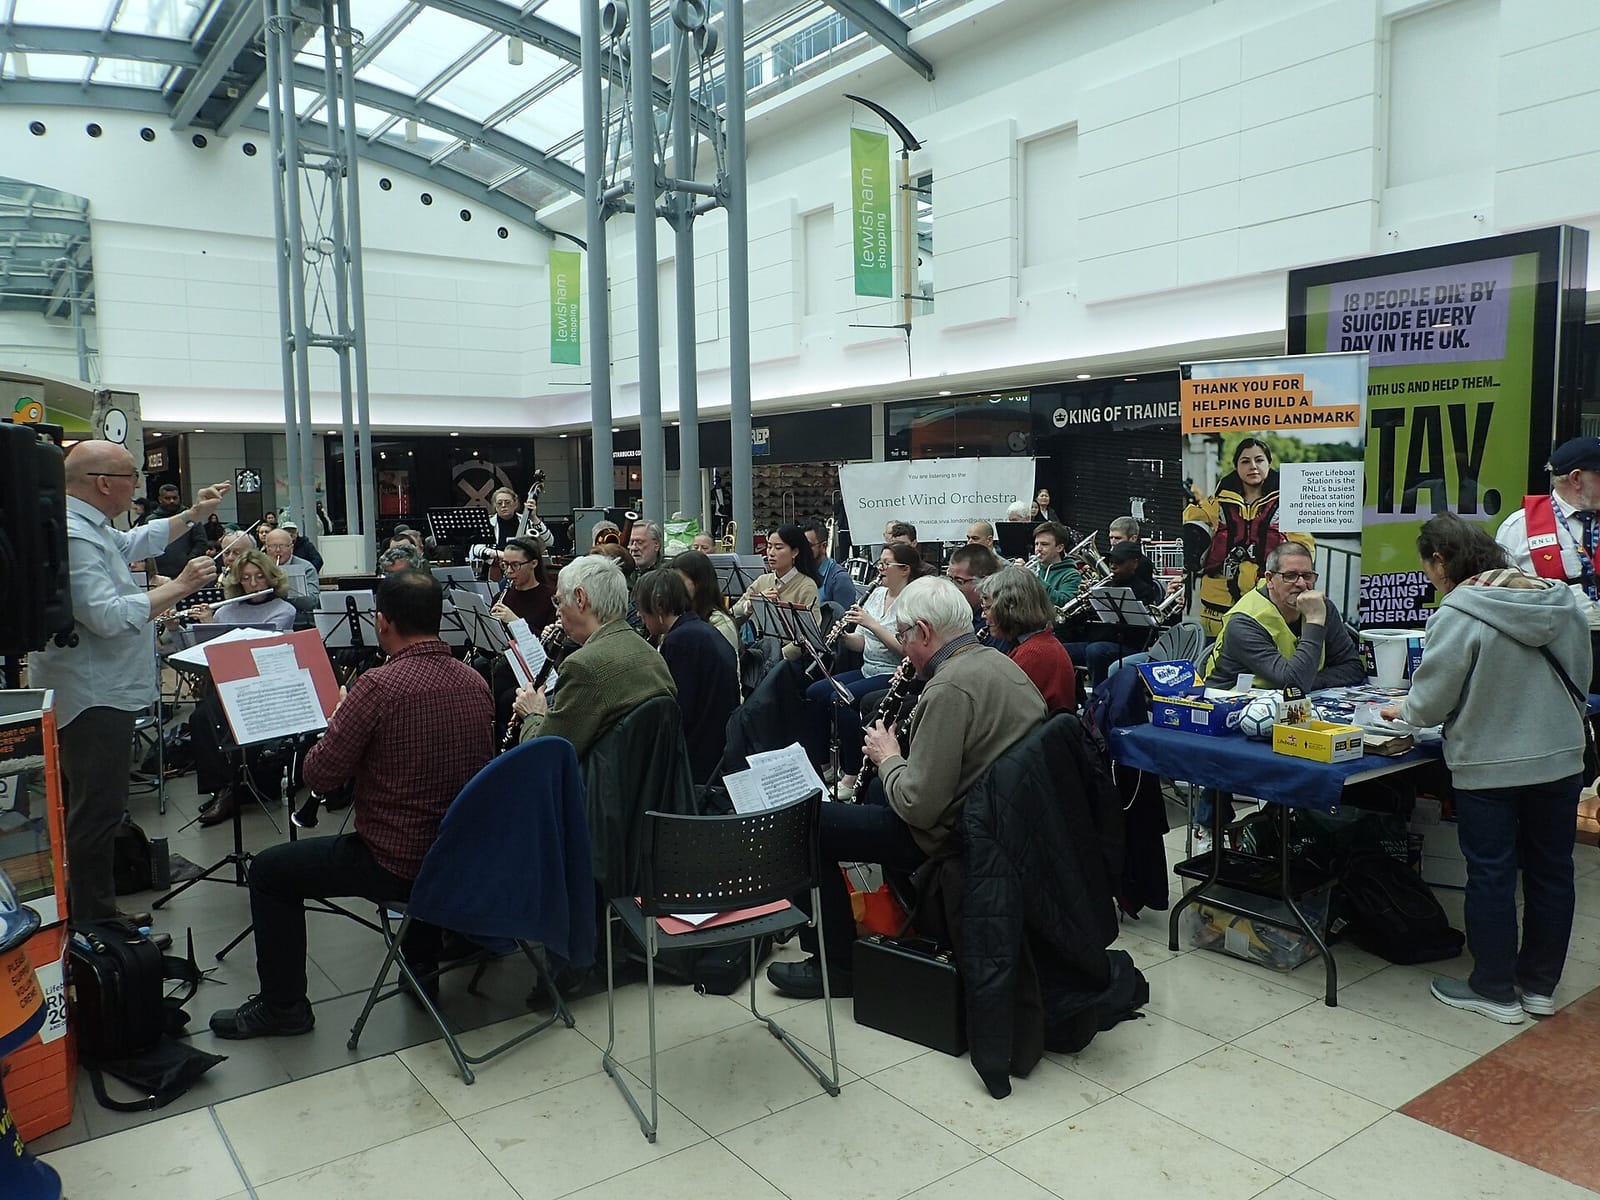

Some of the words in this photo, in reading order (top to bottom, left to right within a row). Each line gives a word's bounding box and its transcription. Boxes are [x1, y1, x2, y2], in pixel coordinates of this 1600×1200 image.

[859, 167, 875, 269] lewisham
[878, 212, 887, 269] shopping
[1343, 293, 1360, 313] 18
[1363, 287, 1430, 311] PEOPLE
[1434, 283, 1466, 305] DIE
[1470, 280, 1497, 303] BY
[555, 273, 568, 342] lewisham
[570, 304, 578, 343] shopping
[1342, 310, 1411, 334] SUICIDE
[1416, 305, 1476, 329] EVERY
[1341, 334, 1374, 352] DAY
[1377, 333, 1396, 353] IN
[1400, 331, 1434, 352] THE
[1438, 328, 1470, 350] UK.
[1193, 382, 1238, 395] THANK
[1242, 380, 1268, 392] YOU
[1273, 379, 1300, 391] FOR
[1391, 382, 1405, 394] US
[1407, 380, 1430, 393] AND
[1432, 378, 1459, 391] HELP
[1193, 398, 1250, 411] HELPING
[1254, 397, 1296, 409] BUILD
[1299, 396, 1309, 407] A
[1069, 407, 1101, 425] KING
[1104, 406, 1122, 422] OF
[1192, 414, 1271, 428] LIFESAVING
[1275, 411, 1355, 425] LANDMARK
[1363, 402, 1501, 515] TAY.
[859, 496, 906, 509] Sonnet
[908, 492, 946, 505] Wind
[950, 491, 1017, 504] Orchestra
[1297, 517, 1322, 525] people
[1531, 537, 1554, 546] RNLI
[1360, 572, 1432, 588] CAMPAI
[1360, 584, 1428, 600] AGAINST
[1360, 608, 1435, 623] MISERAB
[47, 992, 66, 1010] RN
